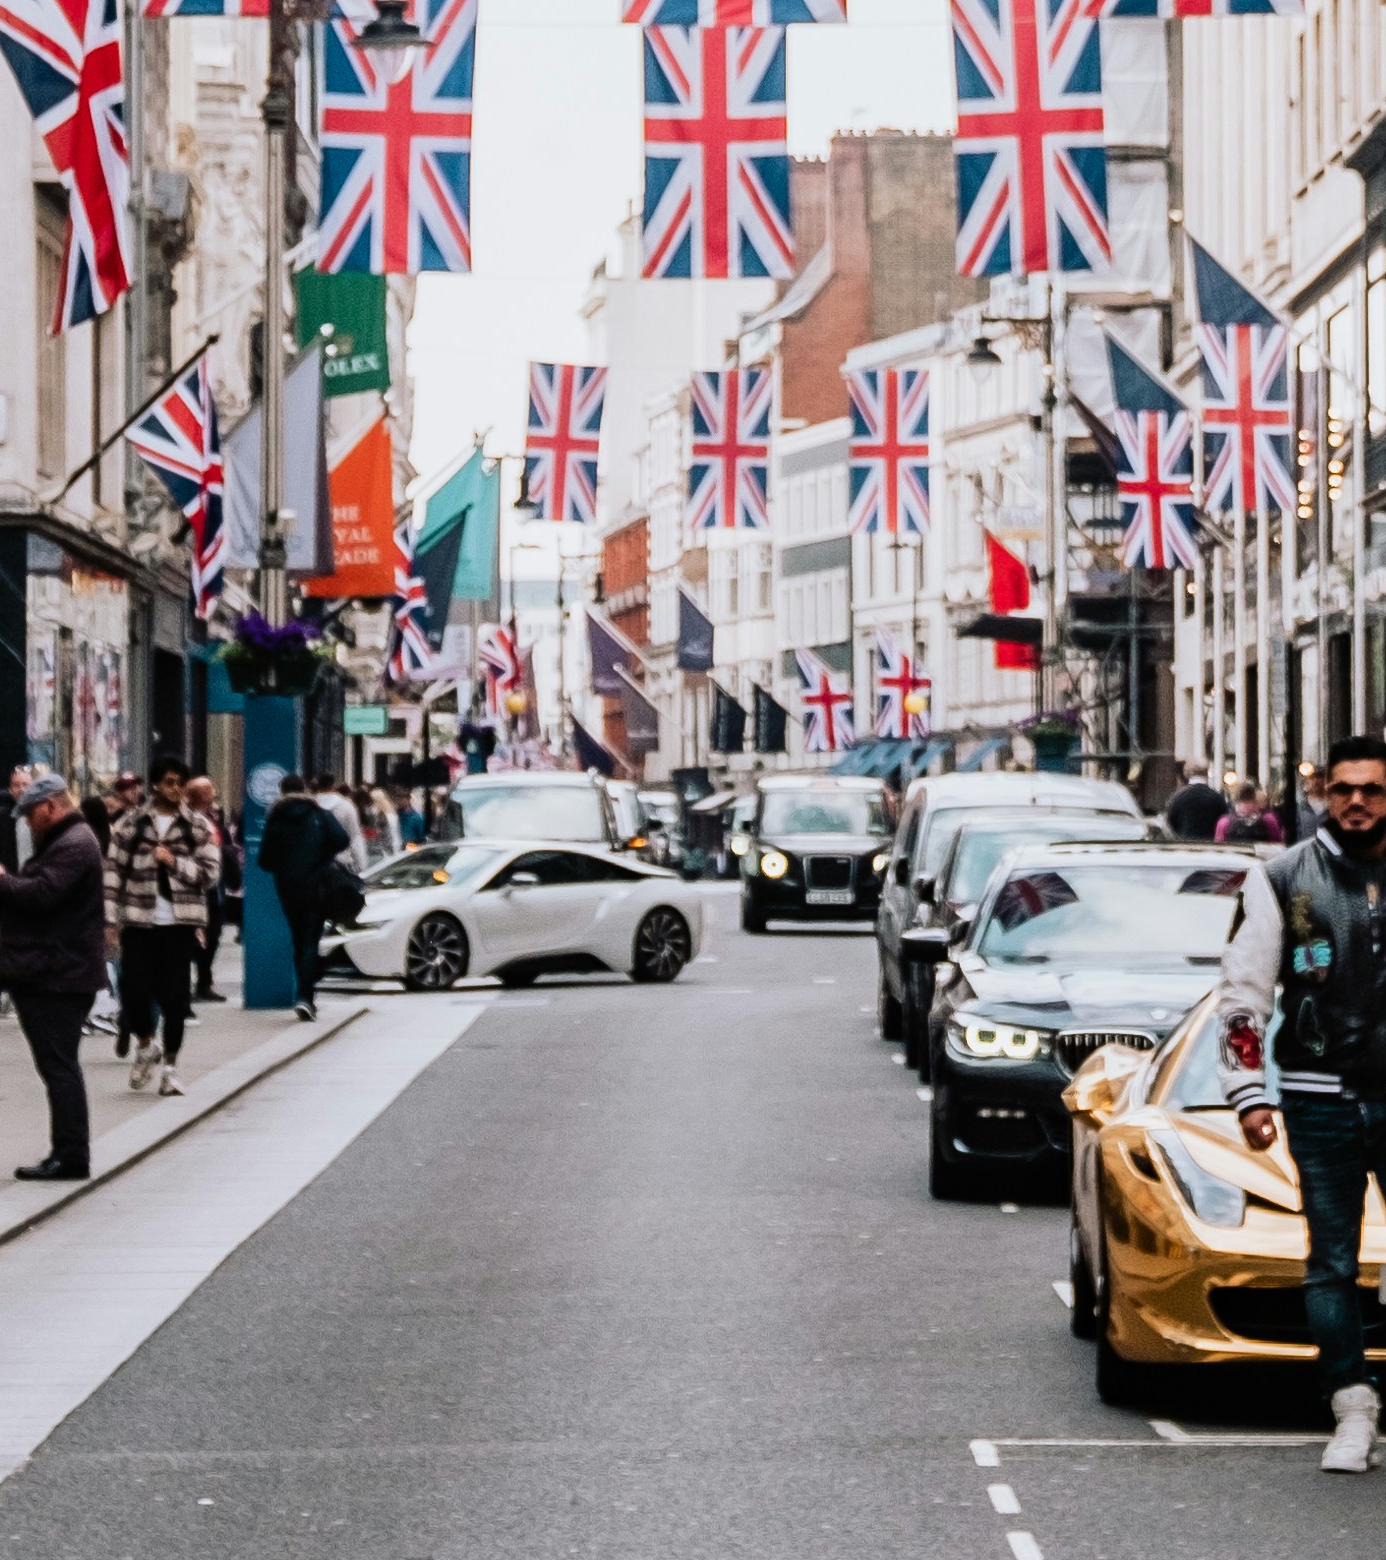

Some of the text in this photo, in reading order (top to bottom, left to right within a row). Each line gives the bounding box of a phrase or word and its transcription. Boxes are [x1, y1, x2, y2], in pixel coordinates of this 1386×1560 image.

[324, 353, 382, 377] OLEX
[333, 506, 360, 523] HE
[335, 527, 373, 543] YAL
